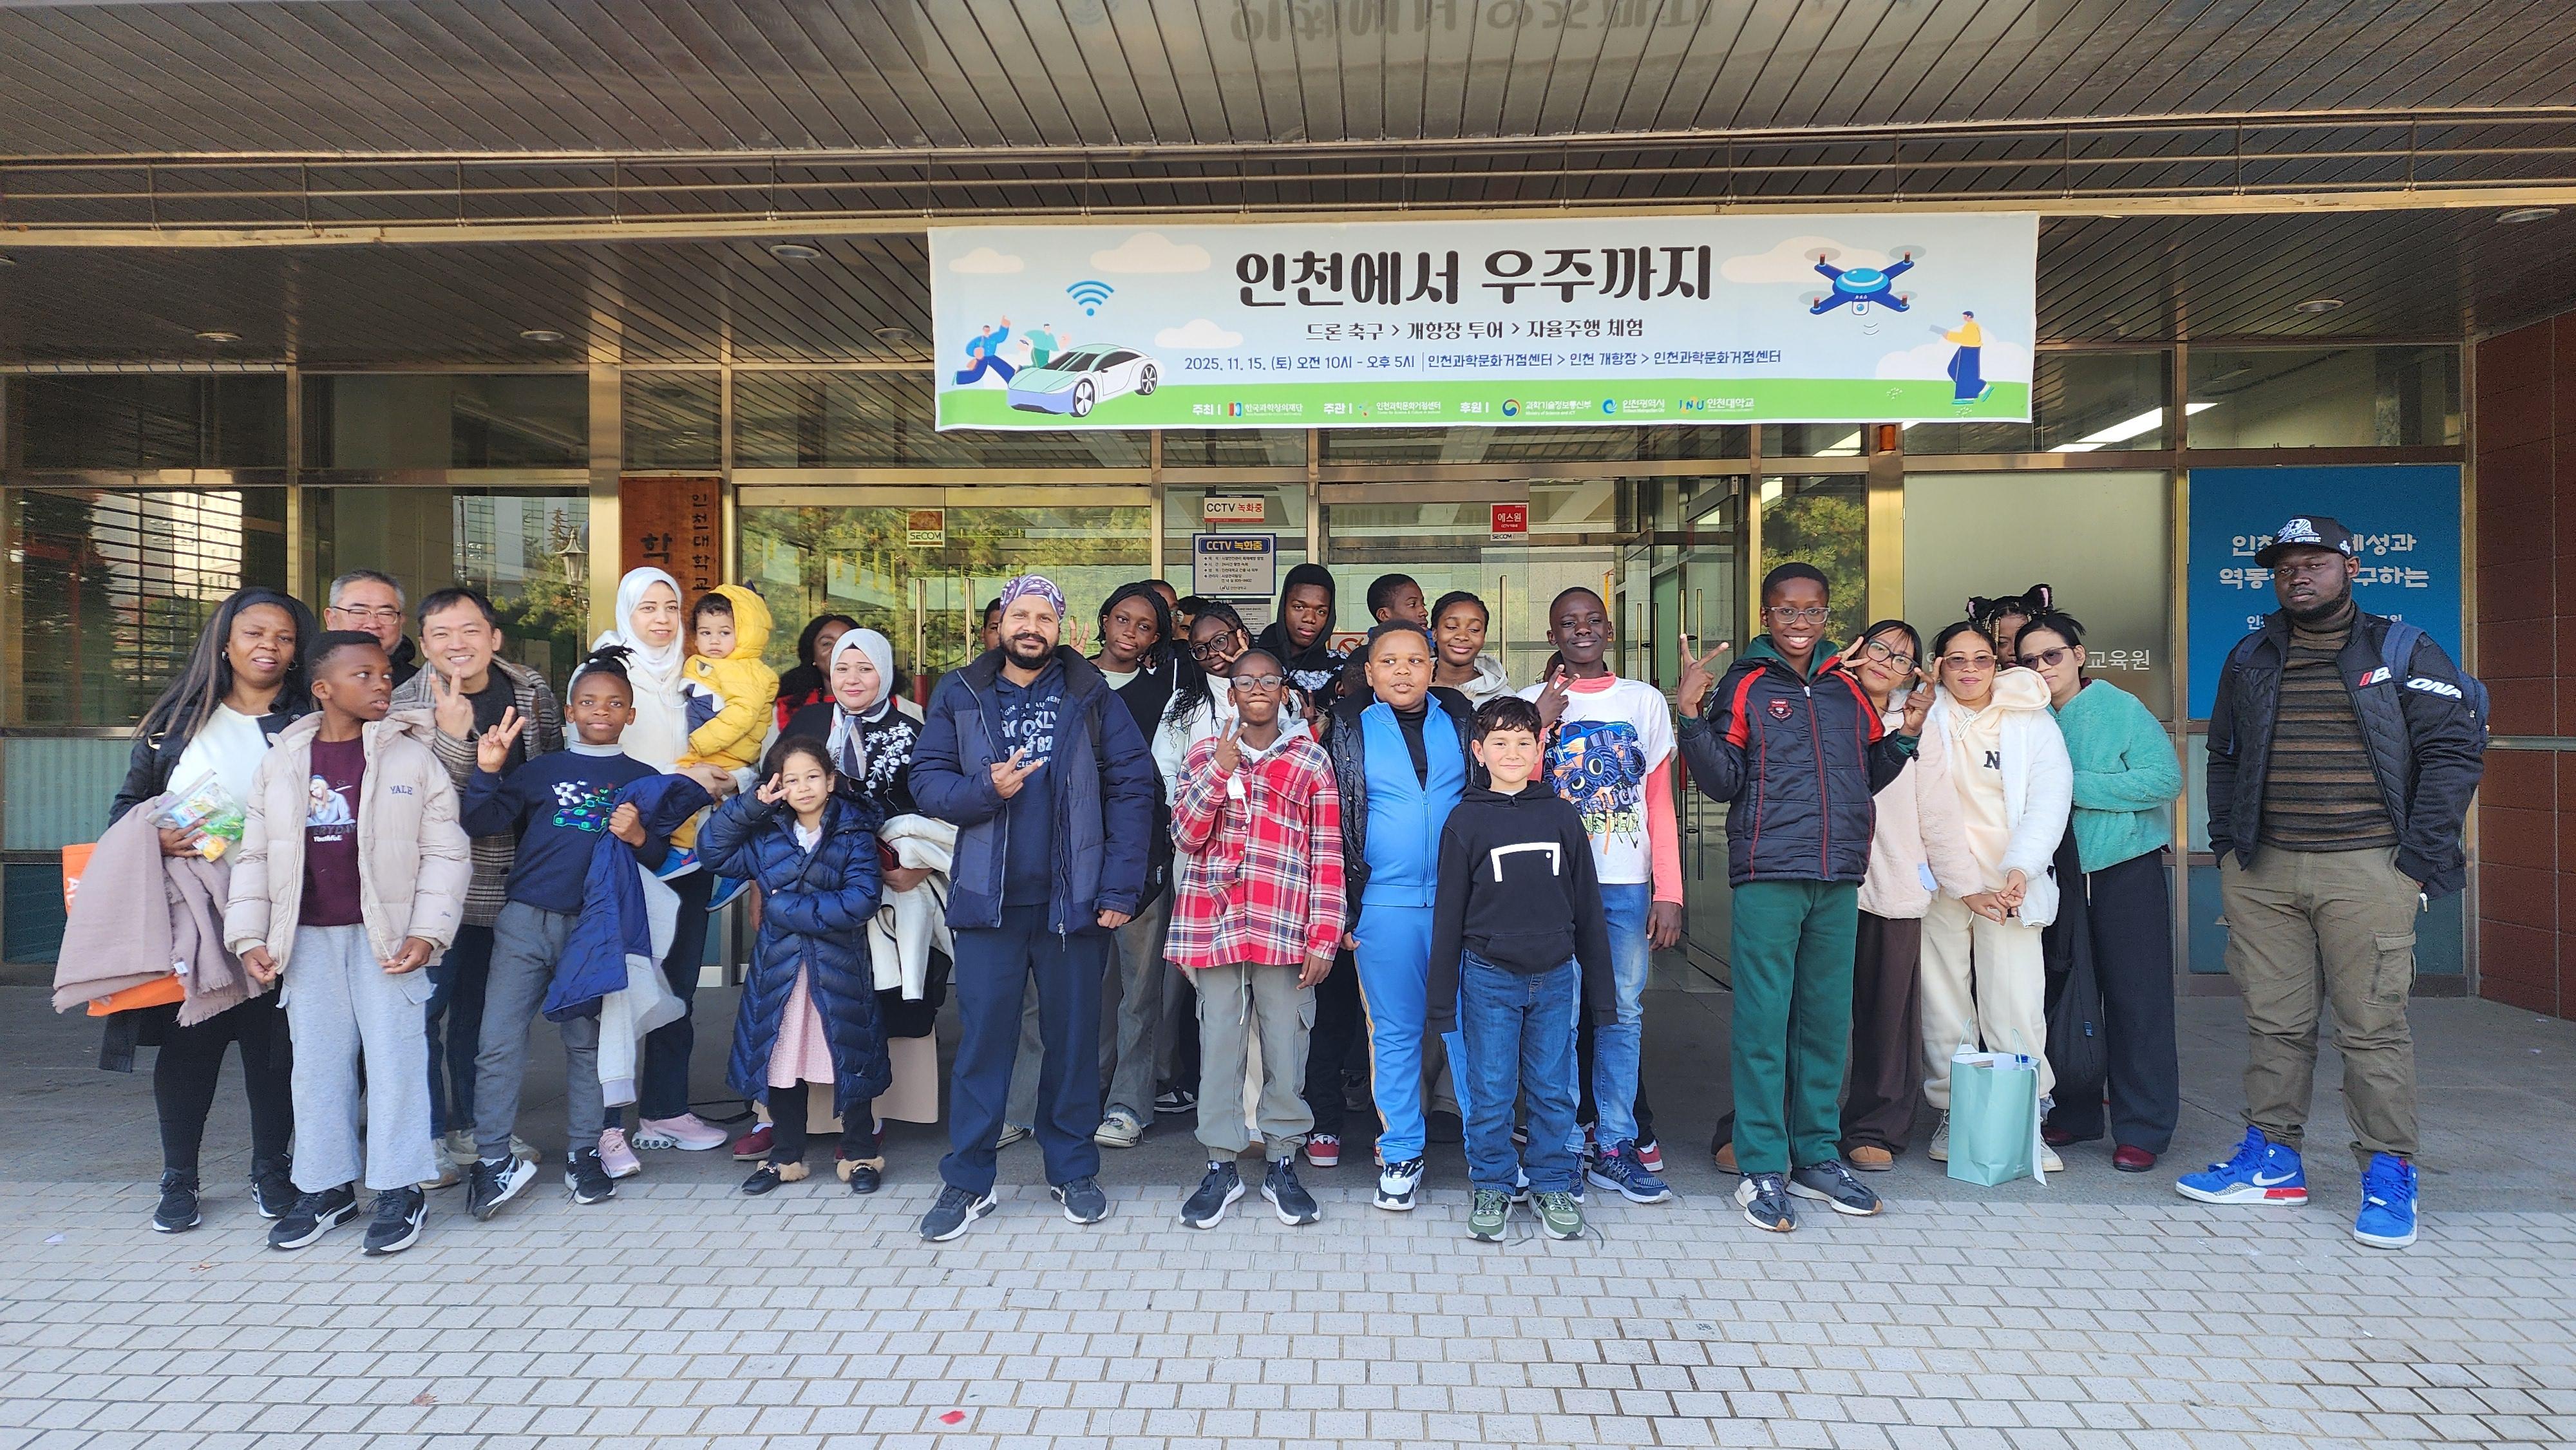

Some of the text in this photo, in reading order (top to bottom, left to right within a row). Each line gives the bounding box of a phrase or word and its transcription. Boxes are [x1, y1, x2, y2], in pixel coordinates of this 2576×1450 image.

[1236, 244, 1712, 308] 인천에서 우주까지
[1306, 323, 1341, 341] 드론
[1349, 322, 1384, 341] 축구
[1407, 321, 1461, 341] 개항장
[1468, 321, 1503, 339] 투어
[1527, 320, 1601, 339] 자율주행
[1607, 319, 1643, 337] 체험
[1184, 357, 1223, 371] 2025.
[1227, 357, 1244, 371] 11.
[1248, 357, 1267, 370] 15.
[1271, 356, 1292, 371] (토)
[1297, 355, 1320, 370] 오전
[1325, 355, 1352, 369] 10시
[1367, 355, 1390, 369] 오후
[1395, 355, 1414, 368] 5시
[1428, 352, 1553, 368] 인천과학문화거점센터
[1569, 353, 1595, 366] 인천
[1600, 352, 1638, 366] 개항장
[1654, 350, 1781, 366] 인천과학문화거점센터
[1324, 403, 1346, 415] 주관
[1377, 401, 1441, 411] 인천과학문화거점센터
[1460, 401, 1482, 414] 후원
[1526, 400, 1591, 410] 과학기술정보통신부
[1623, 399, 1665, 408] 인천광역시
[1707, 398, 1754, 408] 인천대학교
[1193, 404, 1214, 415] 주최
[1206, 503, 1262, 513] CCTV 녹화중
[1497, 513, 1522, 522] 에스원
[692, 493, 710, 591] 인천대학교
[910, 532, 942, 540] SECOM
[640, 532, 673, 564] 학
[1206, 540, 1263, 551] CCTV 녹화중
[2219, 567, 2275, 590] 역동
[390, 785, 413, 795] YALE
[1577, 784, 1641, 814] TRUCK
[1582, 812, 1641, 835] NSTER
